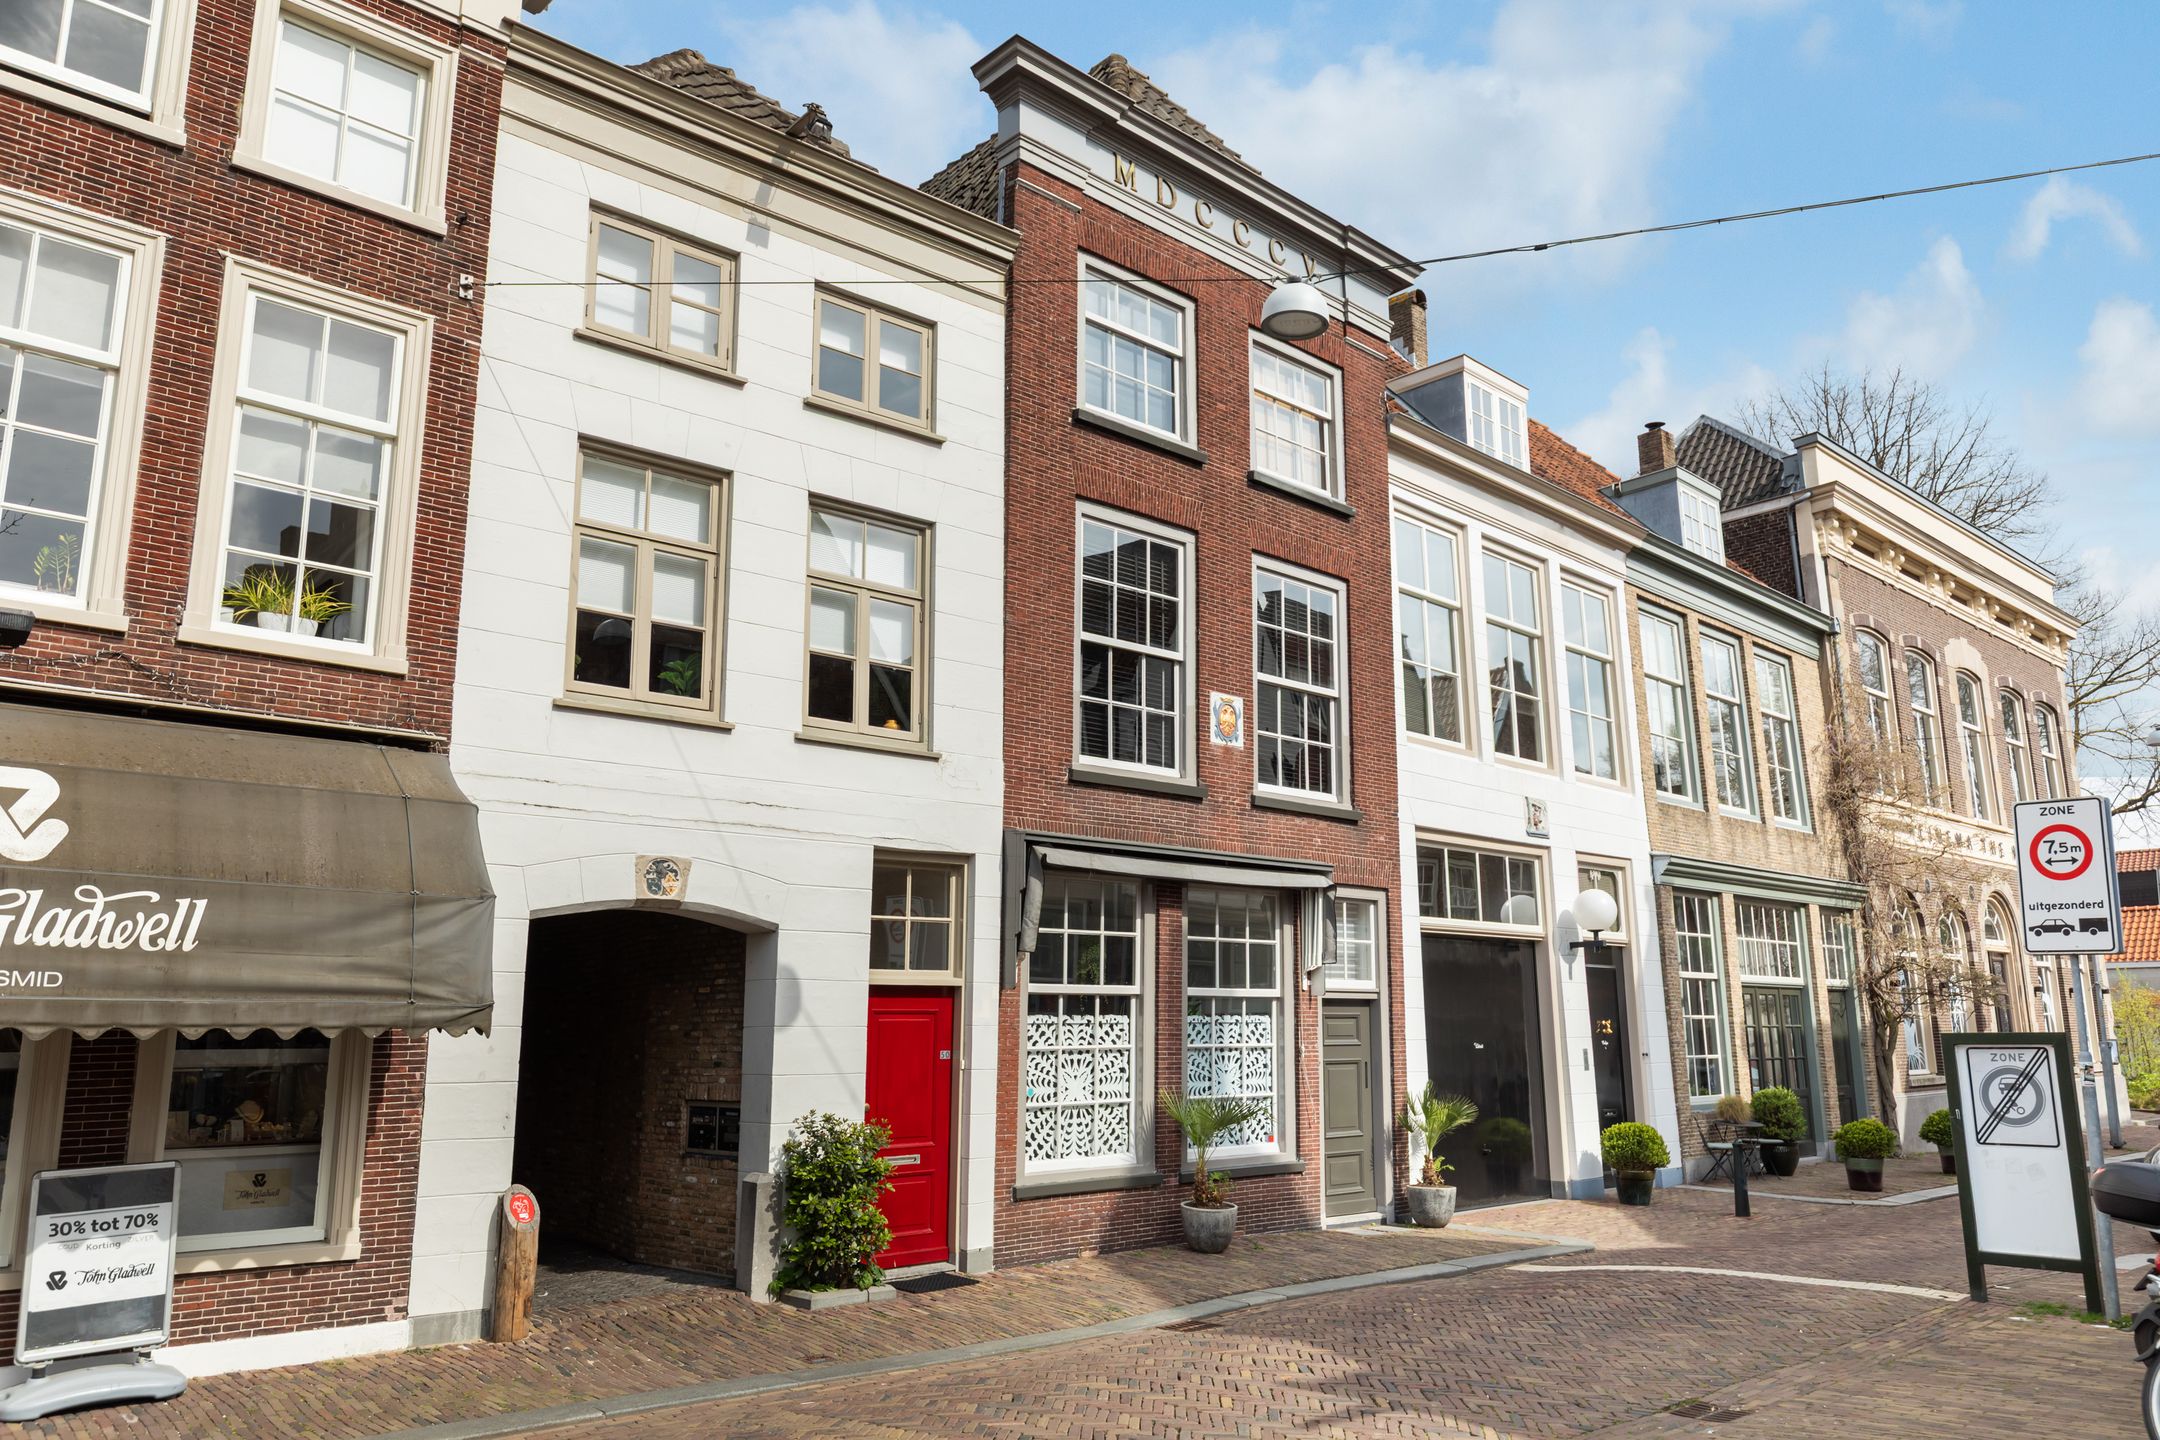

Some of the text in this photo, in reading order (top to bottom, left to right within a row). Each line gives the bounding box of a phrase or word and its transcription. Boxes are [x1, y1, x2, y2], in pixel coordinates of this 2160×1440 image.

[2039, 805, 2075, 816] ZONE
[2028, 900, 2104, 912] uitgezonderd
[1990, 1053, 2026, 1062] ZONE
[48, 1213, 159, 1237] 30% tot 70%
[86, 1241, 121, 1251] Korting
[74, 1263, 155, 1286] John Gladwell
